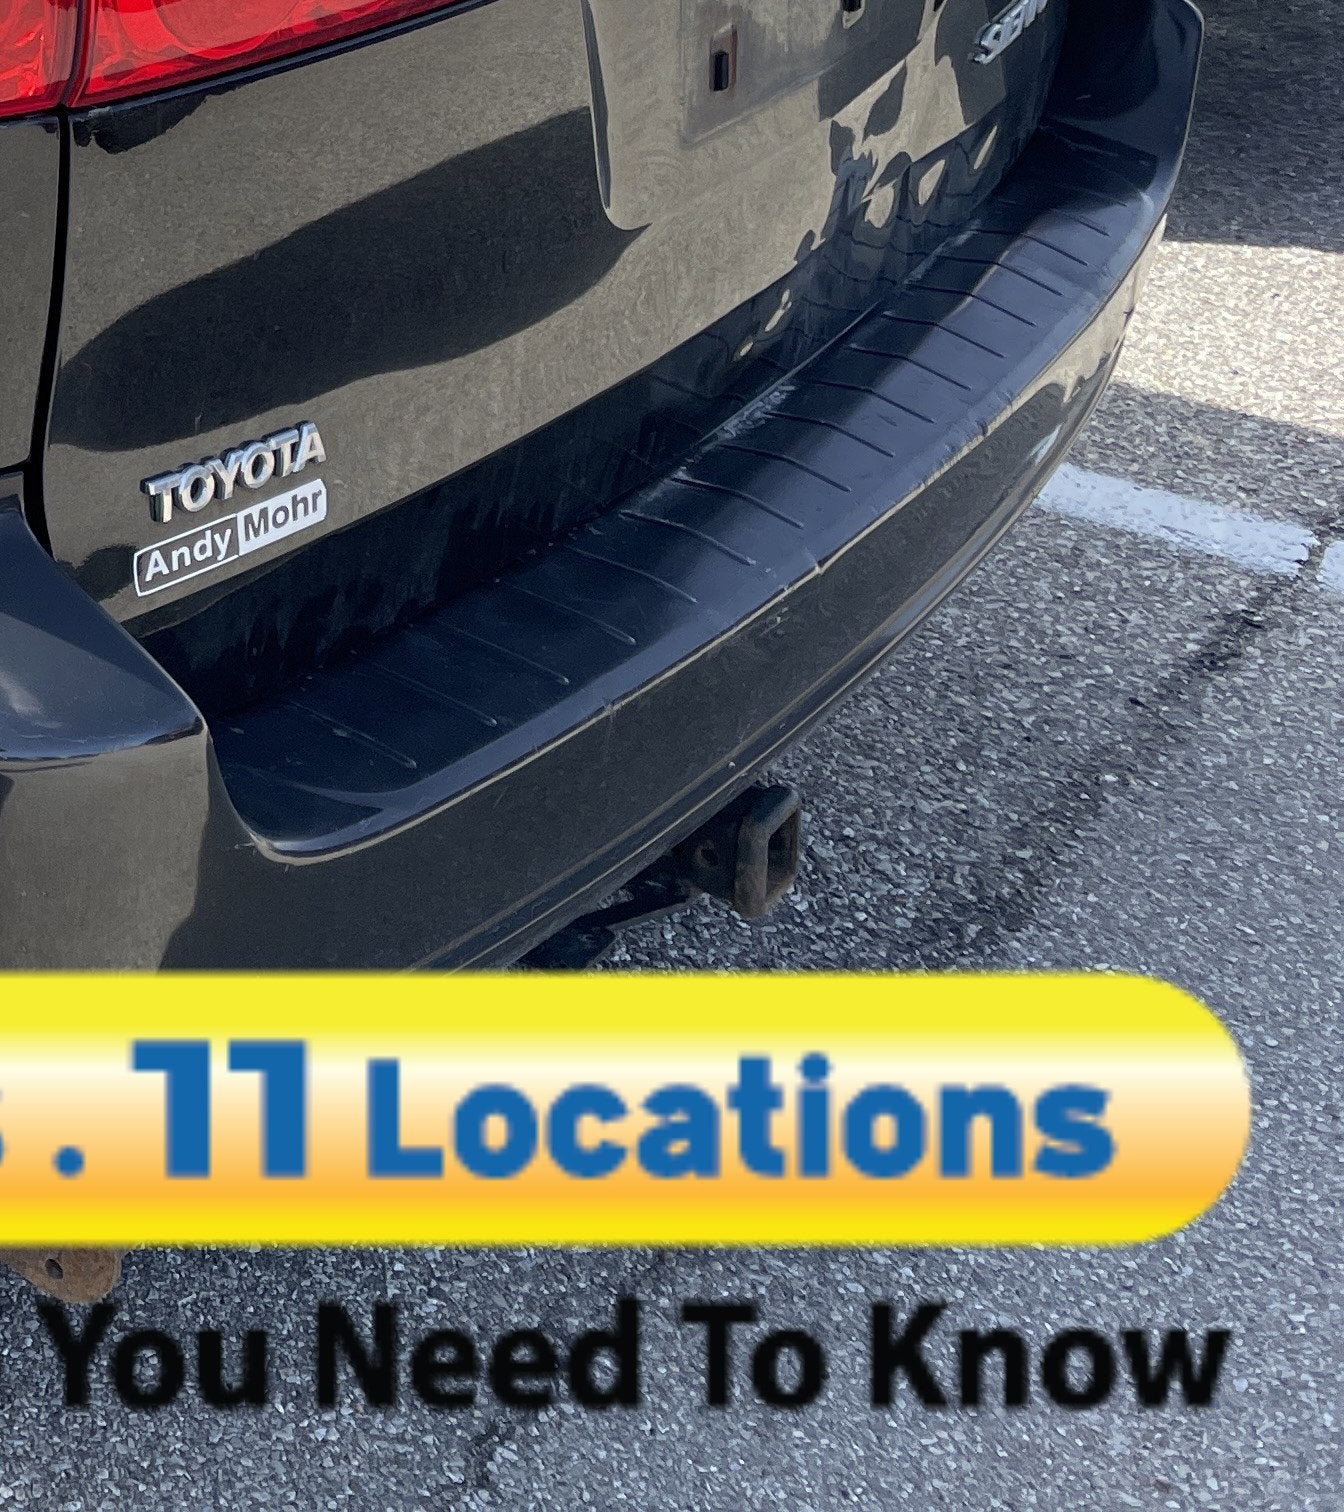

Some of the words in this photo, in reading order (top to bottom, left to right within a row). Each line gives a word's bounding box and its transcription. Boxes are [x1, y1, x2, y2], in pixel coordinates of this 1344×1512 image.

[140, 419, 327, 524] TOYOTA
[143, 525, 234, 582] Andy
[243, 488, 323, 542] Mohr
